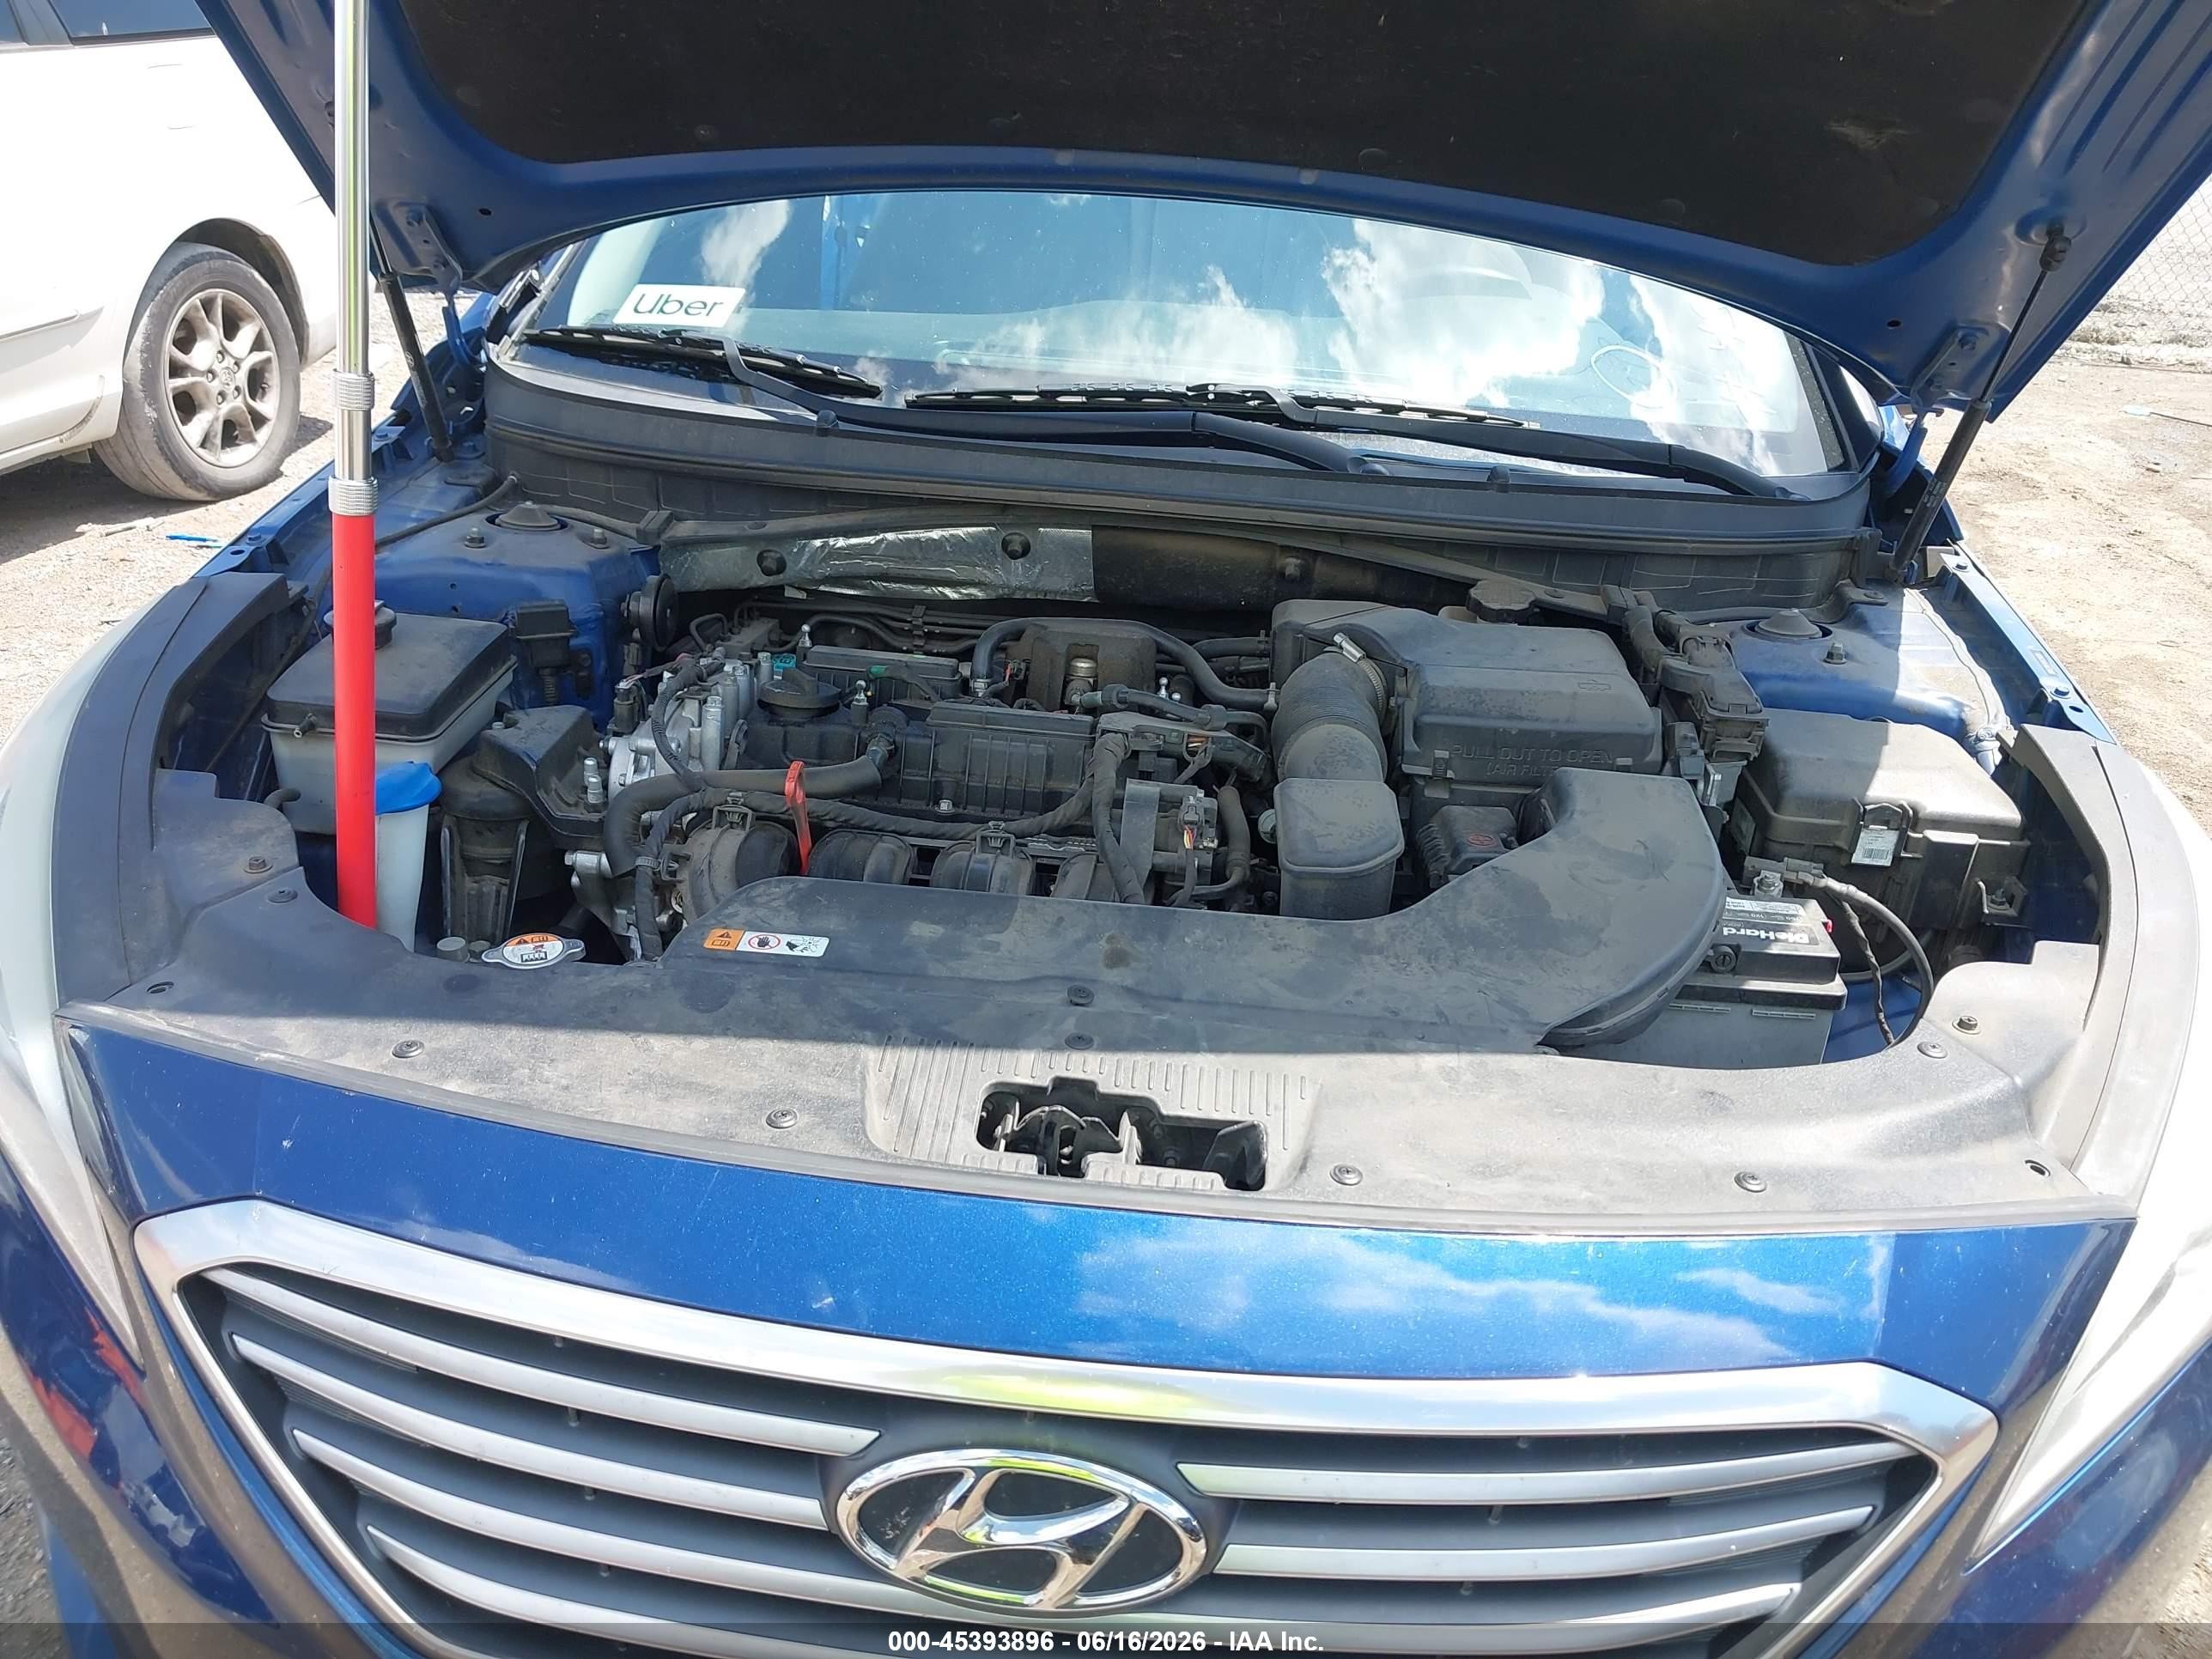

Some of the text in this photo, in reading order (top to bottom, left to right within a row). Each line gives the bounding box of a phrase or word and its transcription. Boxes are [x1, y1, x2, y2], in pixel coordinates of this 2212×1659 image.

[634, 294, 724, 316] Uber
[1450, 744, 1614, 764] PULL OUT TO OPEN
[1723, 927, 1810, 944] DieHard
